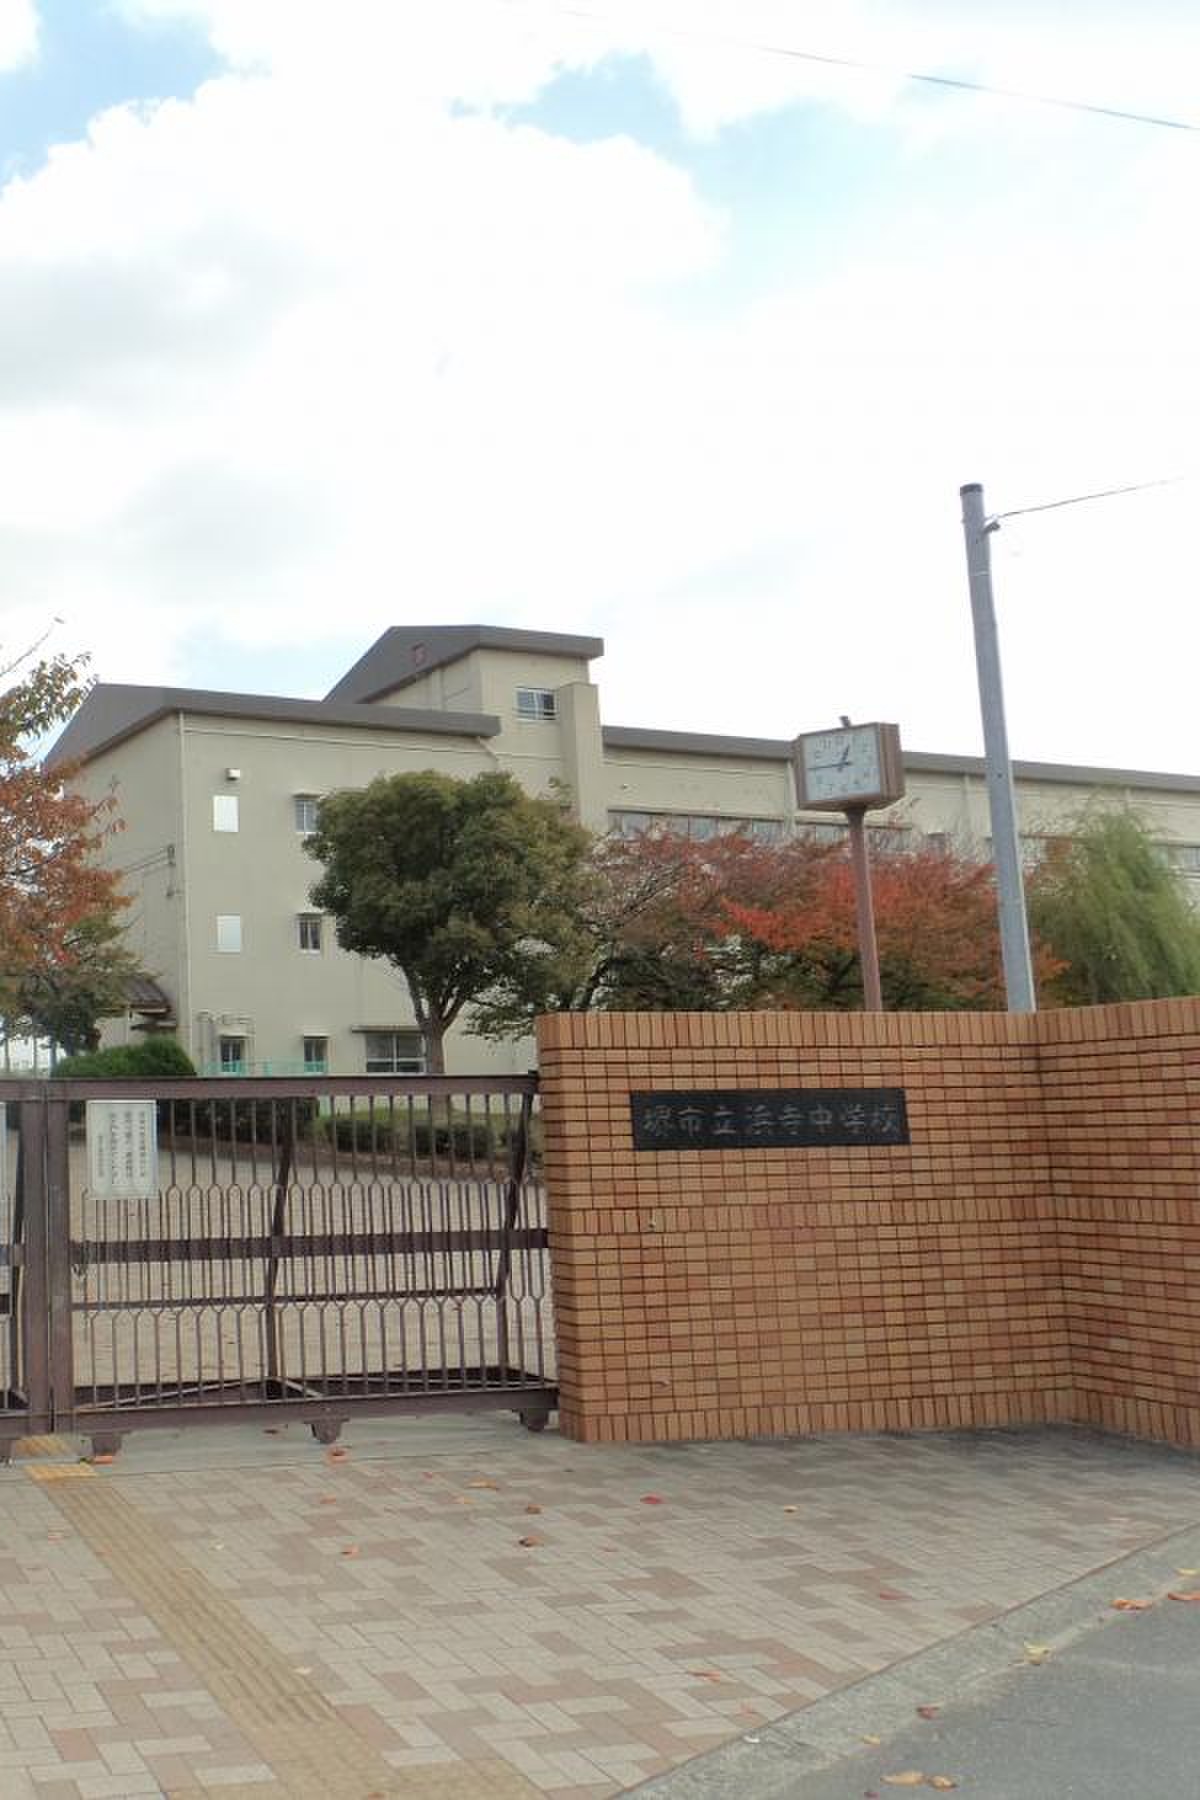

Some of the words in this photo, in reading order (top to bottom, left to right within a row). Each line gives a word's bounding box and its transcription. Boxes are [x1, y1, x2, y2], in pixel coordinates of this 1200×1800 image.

[644, 1104, 901, 1136] 堺市立浜寺中学校
